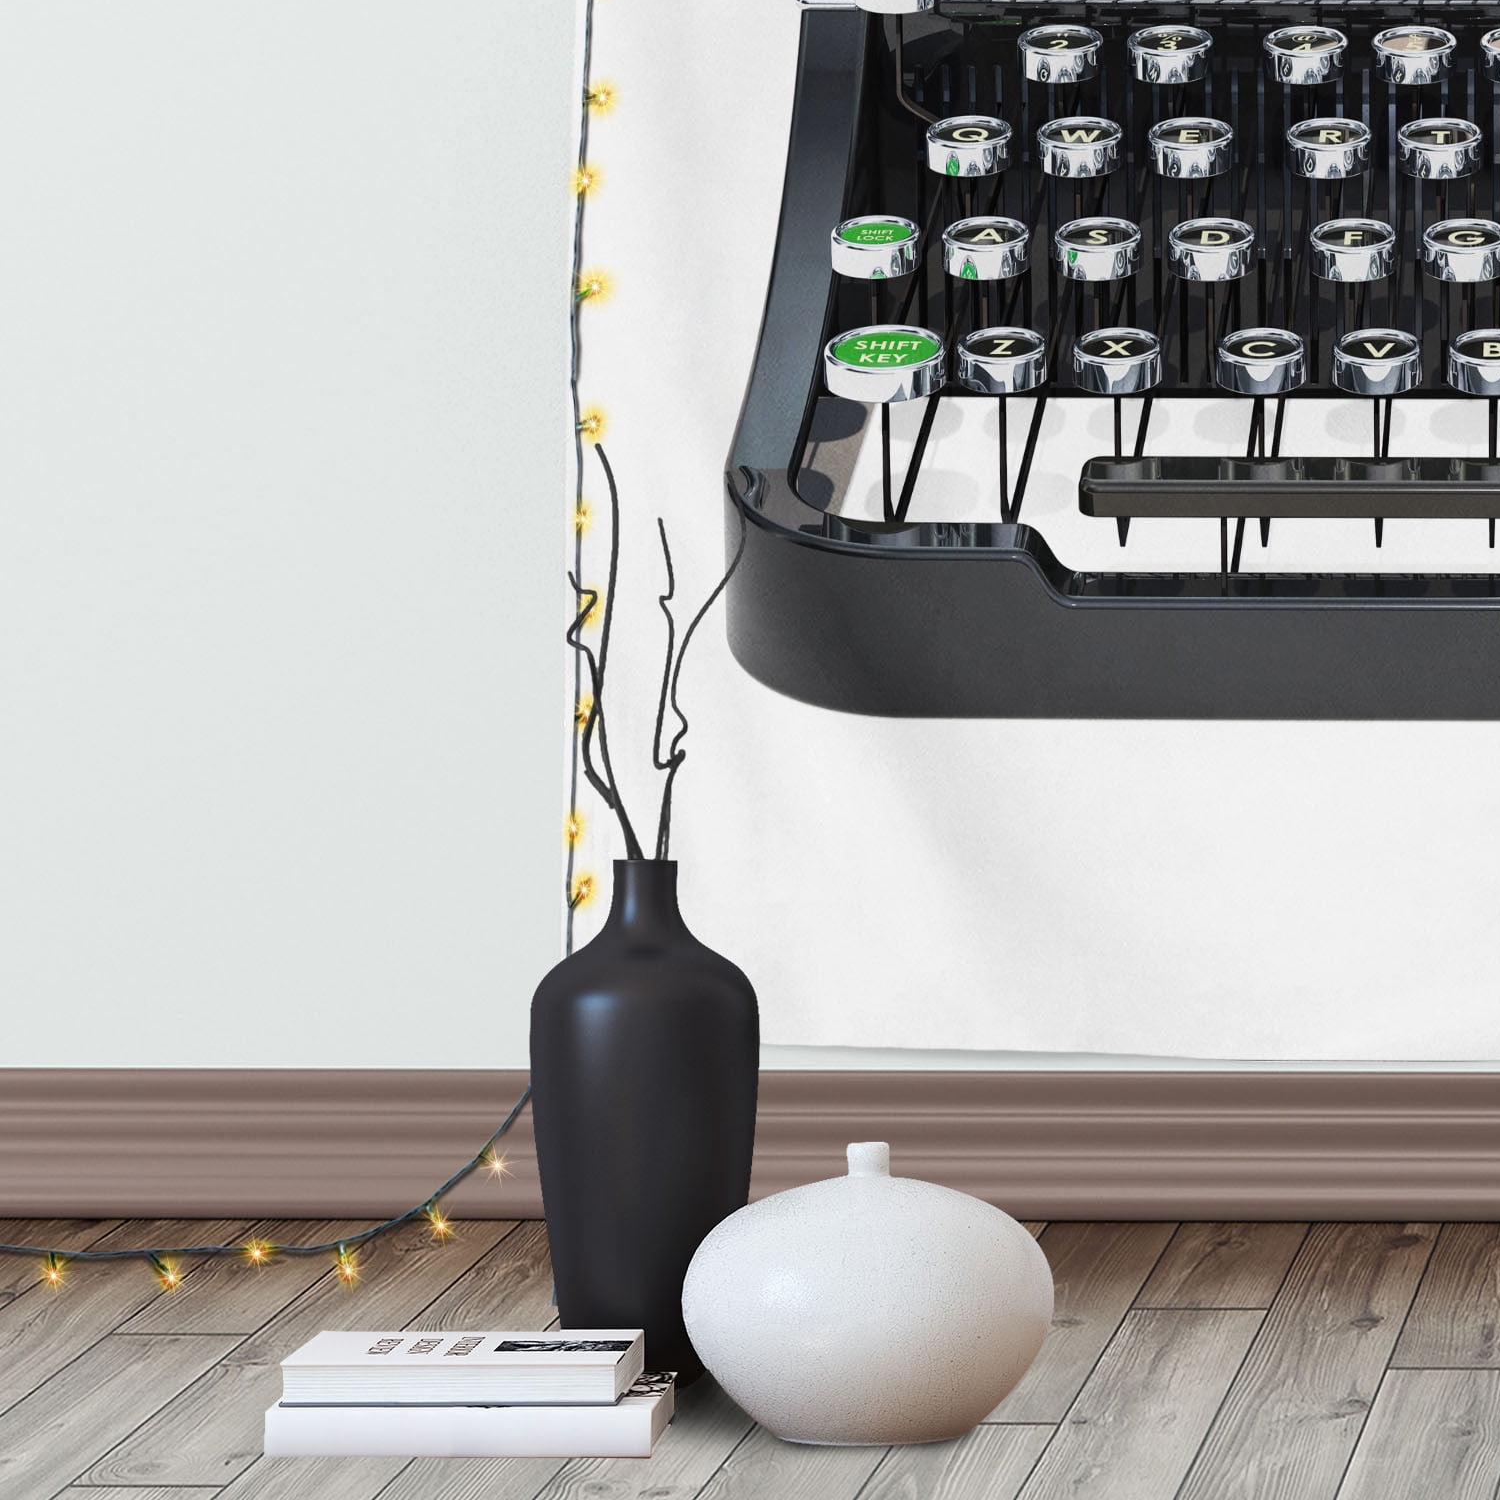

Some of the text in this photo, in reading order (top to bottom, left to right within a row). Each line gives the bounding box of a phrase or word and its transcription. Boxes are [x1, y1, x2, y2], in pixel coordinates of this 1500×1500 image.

[1049, 39, 1069, 50] 2
[1156, 40, 1178, 50] 3
[952, 128, 989, 142] Q
[1060, 129, 1101, 143] W
[1178, 129, 1201, 143] E
[1318, 130, 1342, 143] R
[1430, 130, 1451, 144] T
[970, 228, 1004, 243] A
[1085, 229, 1109, 245] S
[1200, 230, 1230, 245] D
[1343, 231, 1363, 246] F
[1448, 231, 1486, 246] G
[854, 340, 922, 351] SHIFT
[989, 339, 1015, 355] Z
[1100, 340, 1133, 356] X
[1241, 341, 1276, 357] C
[1363, 342, 1396, 358] V
[858, 353, 908, 364] KEY
